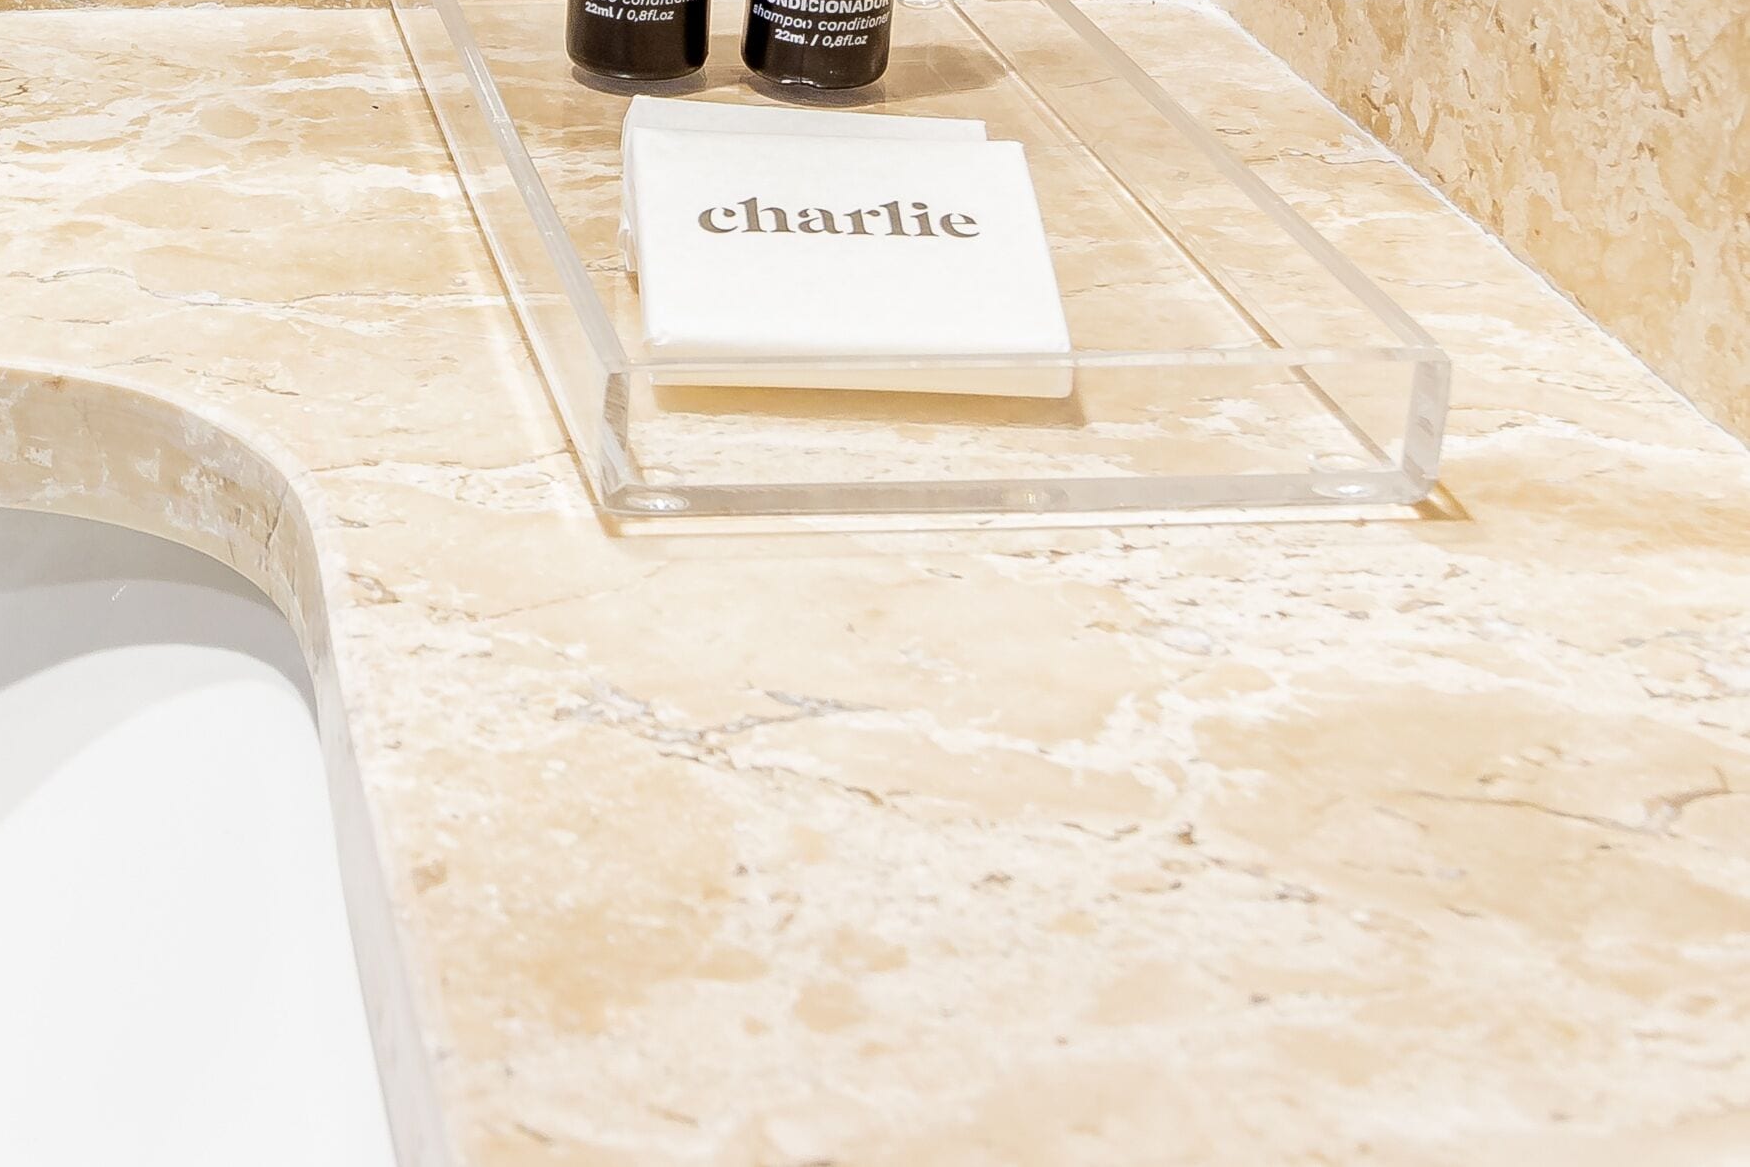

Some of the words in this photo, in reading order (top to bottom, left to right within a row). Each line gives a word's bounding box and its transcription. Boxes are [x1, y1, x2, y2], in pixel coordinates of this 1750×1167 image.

[585, 1, 614, 18] 22ml
[818, 11, 891, 31] conditioner
[697, 197, 980, 239] charlie
